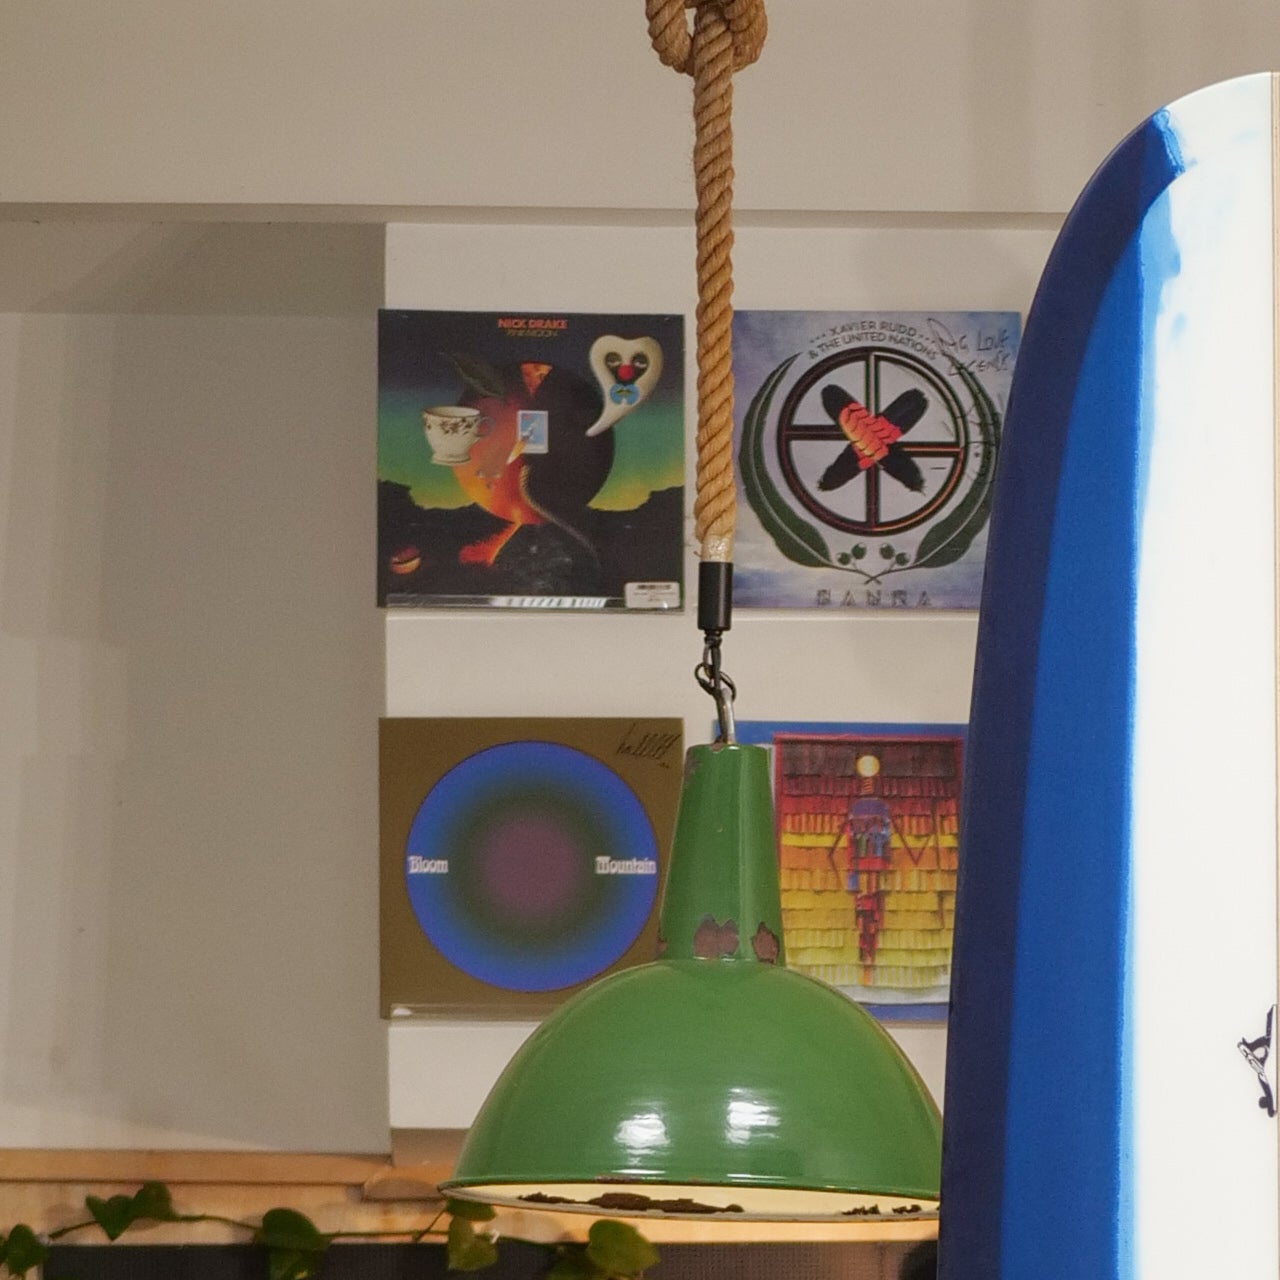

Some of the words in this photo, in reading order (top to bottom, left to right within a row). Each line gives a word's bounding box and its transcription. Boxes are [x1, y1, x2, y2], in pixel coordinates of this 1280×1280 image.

[829, 320, 877, 337] XAVIER
[879, 320, 917, 337] RUDD
[817, 337, 841, 353] THE
[843, 331, 886, 345] UNITED
[888, 334, 937, 361] NATIONS
[408, 855, 449, 874] Bloom
[595, 855, 657, 875] Mountain
